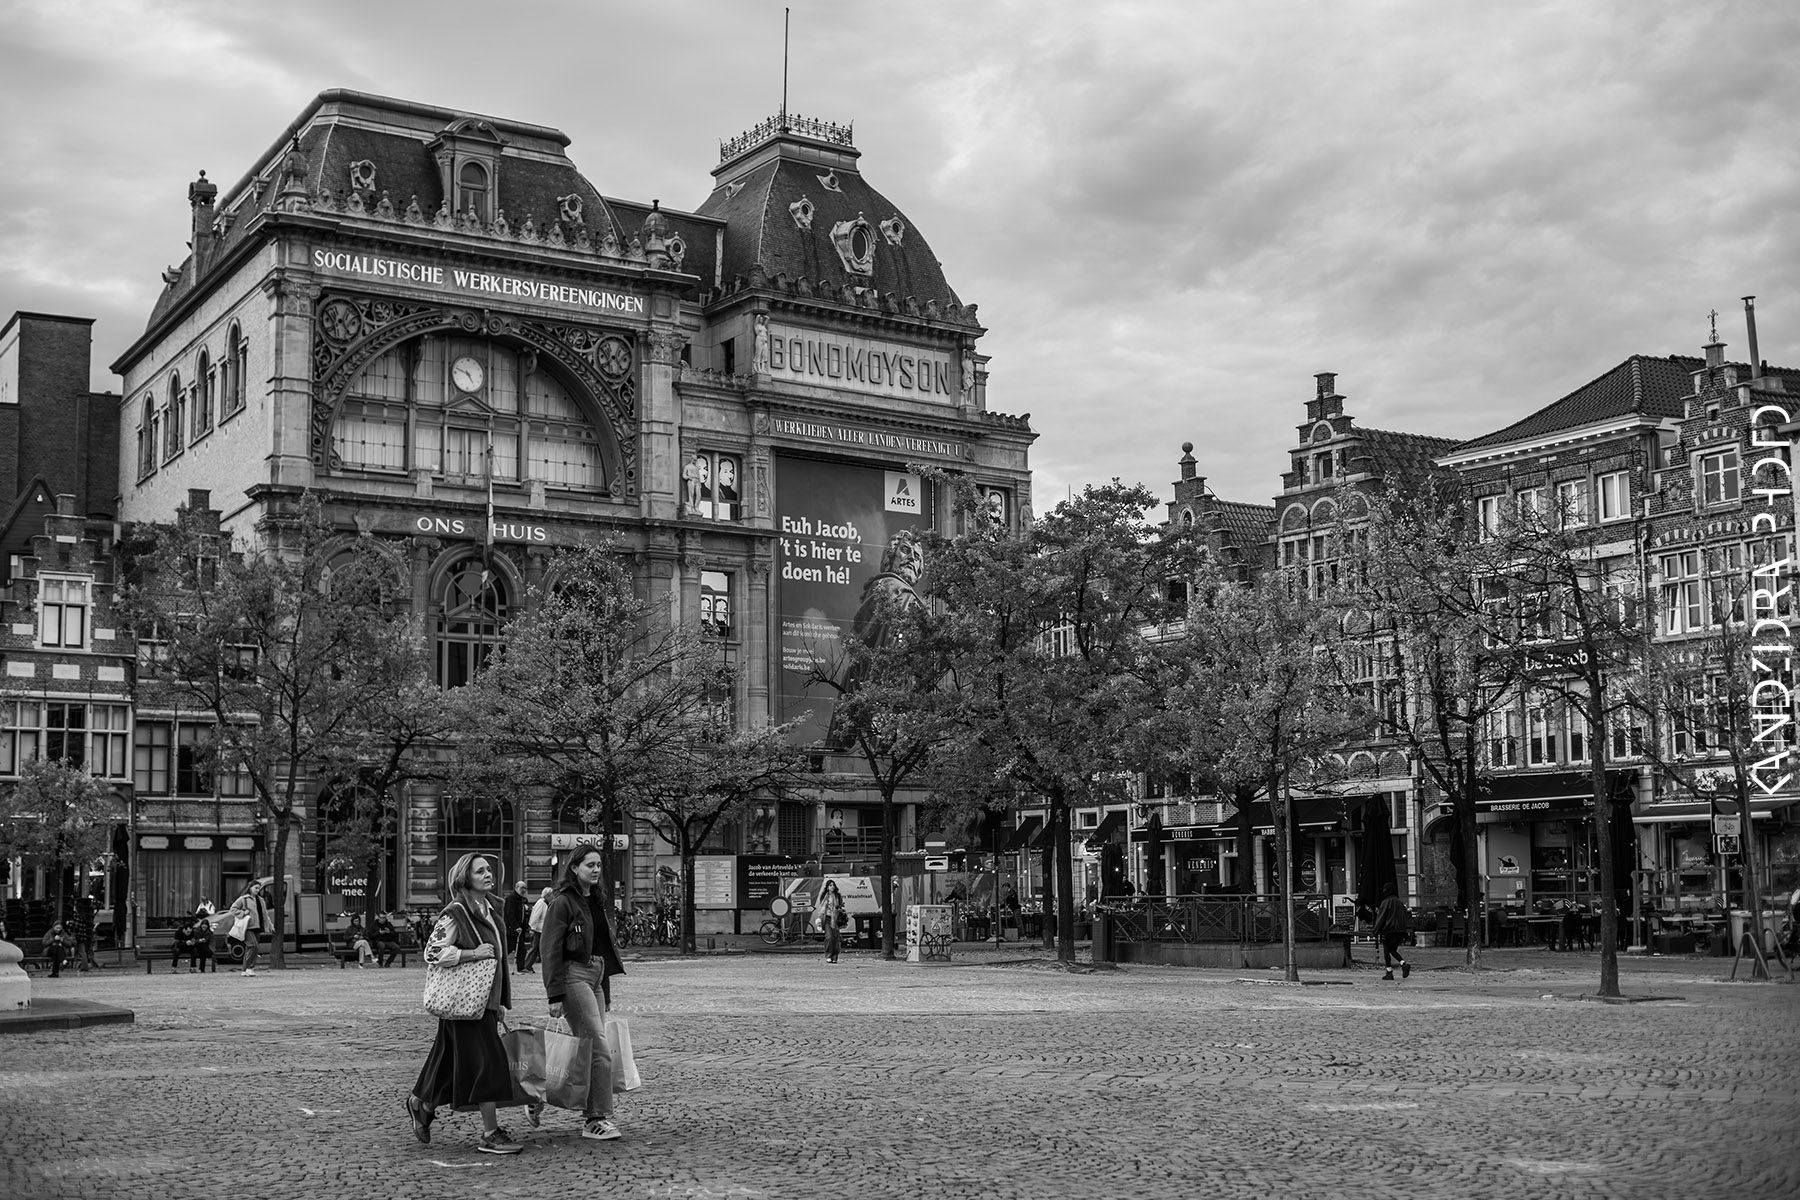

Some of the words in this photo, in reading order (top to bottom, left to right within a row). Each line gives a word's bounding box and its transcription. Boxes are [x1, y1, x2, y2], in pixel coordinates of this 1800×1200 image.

[314, 250, 443, 285] SOCIALISTISCHE
[453, 270, 644, 313] WERKERSVEREENIGINGEN
[774, 419, 833, 440] WERKLIEDEN
[836, 427, 864, 444] ALLER
[868, 432, 902, 448] LANDEN
[905, 438, 951, 456] VEREENIGT
[954, 443, 960, 457] U
[890, 496, 916, 508] ARTES
[416, 516, 465, 534] ONS
[493, 522, 546, 541] HUIS
[782, 515, 812, 535] Euh
[816, 519, 862, 544] Jacob,
[794, 539, 808, 558] is
[811, 541, 843, 561] hier
[846, 545, 862, 563] te
[782, 561, 822, 583] doen
[826, 564, 850, 585] hé!
[1490, 803, 1520, 812] BRASSERIE
[1531, 802, 1550, 811] JACOB
[576, 836, 624, 848] Solidis
[331, 875, 368, 886] Iedree
[341, 888, 366, 896] mee.
